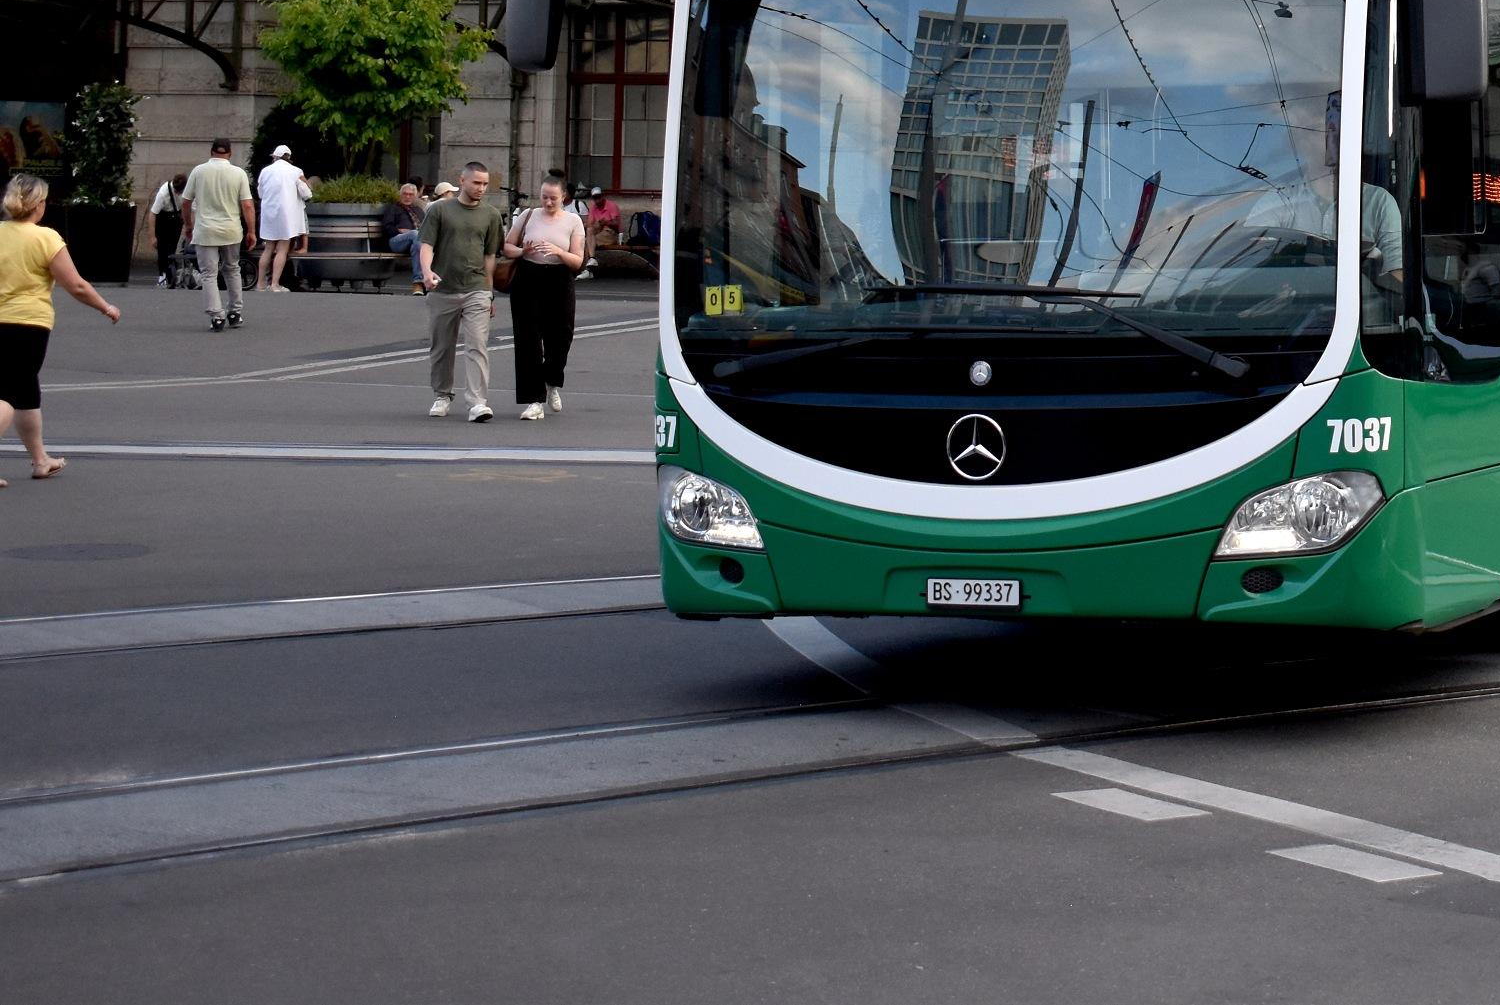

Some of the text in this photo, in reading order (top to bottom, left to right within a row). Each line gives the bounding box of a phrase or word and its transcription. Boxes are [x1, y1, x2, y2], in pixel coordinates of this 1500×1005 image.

[1327, 416, 1392, 453] 7037
[933, 582, 1013, 603] BS 99337
